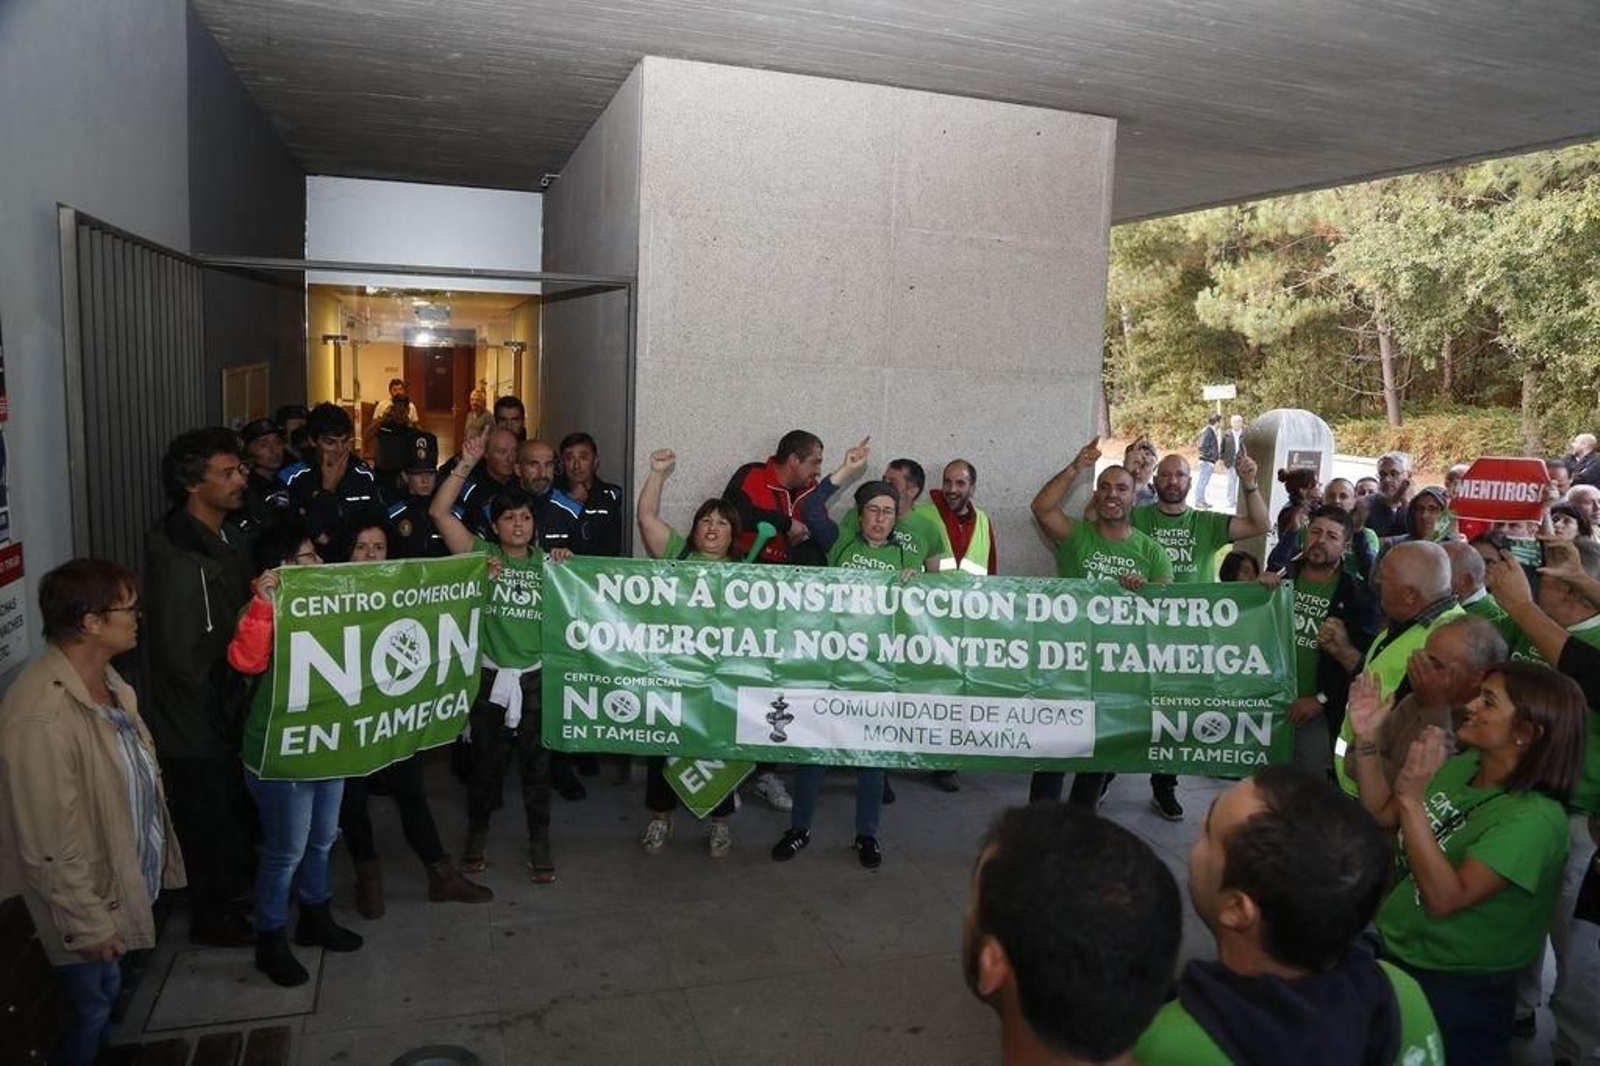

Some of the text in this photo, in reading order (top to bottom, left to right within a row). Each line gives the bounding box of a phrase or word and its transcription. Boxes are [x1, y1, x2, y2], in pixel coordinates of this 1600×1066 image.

[1093, 551, 1135, 568] CENTRO
[290, 580, 483, 618] CENTRO COMERCIAL
[596, 573, 679, 606] NON
[724, 578, 1016, 622] CONSTRUCCIÓN
[1025, 592, 1078, 624] DO
[1086, 595, 1239, 627] CENTRO
[287, 608, 480, 713] NON
[565, 619, 1272, 676] COMERCIAL NOS MONTES DE TAMEIGA
[563, 672, 682, 687] CENTRO COMERCIAL
[563, 685, 682, 727] NON
[813, 697, 1084, 726] COMUNIDADE DE AUGAS
[1151, 696, 1273, 708] CENTRO COMERCIAL
[280, 689, 470, 756] EN TAMEIGA
[562, 725, 680, 744] EN TAMEIGA
[863, 724, 1032, 750] MONTE BAXIÑA
[1151, 710, 1273, 746] NON
[1148, 747, 1269, 766] EN TAMEIGA
